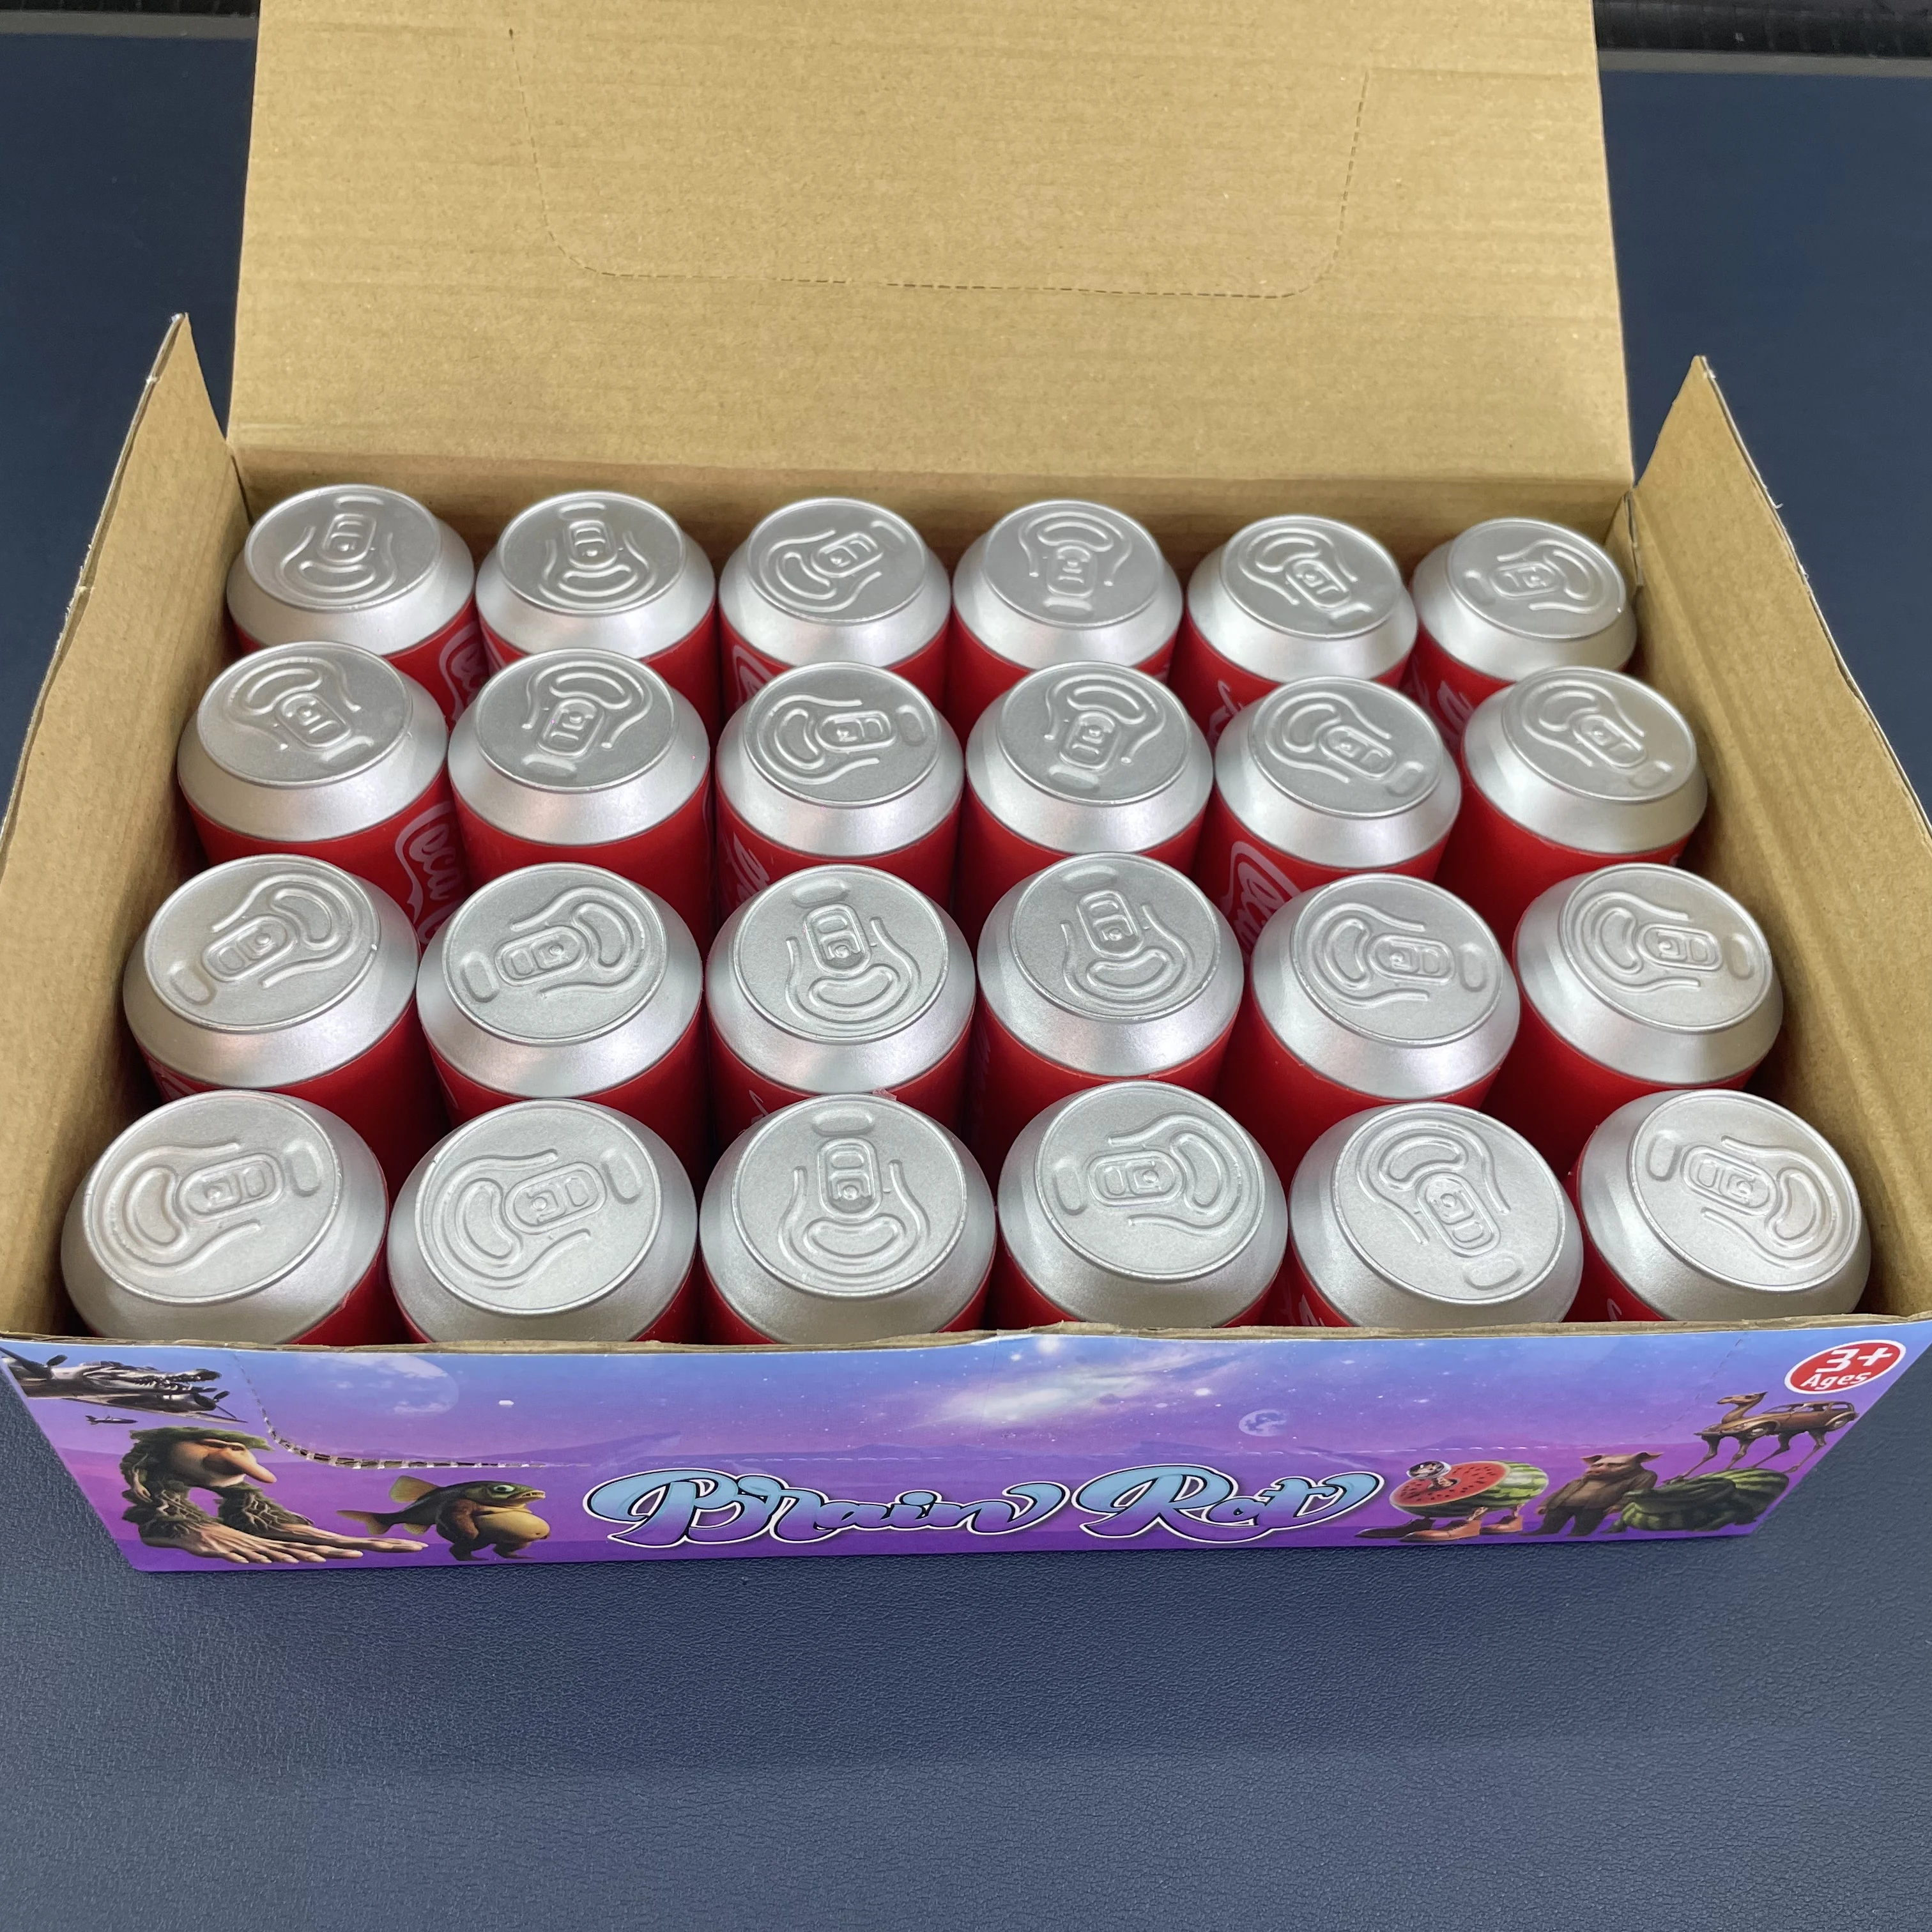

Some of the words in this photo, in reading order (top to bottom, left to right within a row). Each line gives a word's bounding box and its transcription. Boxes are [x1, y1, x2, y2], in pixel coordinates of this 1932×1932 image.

[1815, 1347, 1893, 1373] 3+
[1800, 1372, 1871, 1390] Ages
[582, 1468, 1071, 1548] Brain
[1071, 1463, 1385, 1544] Rot
